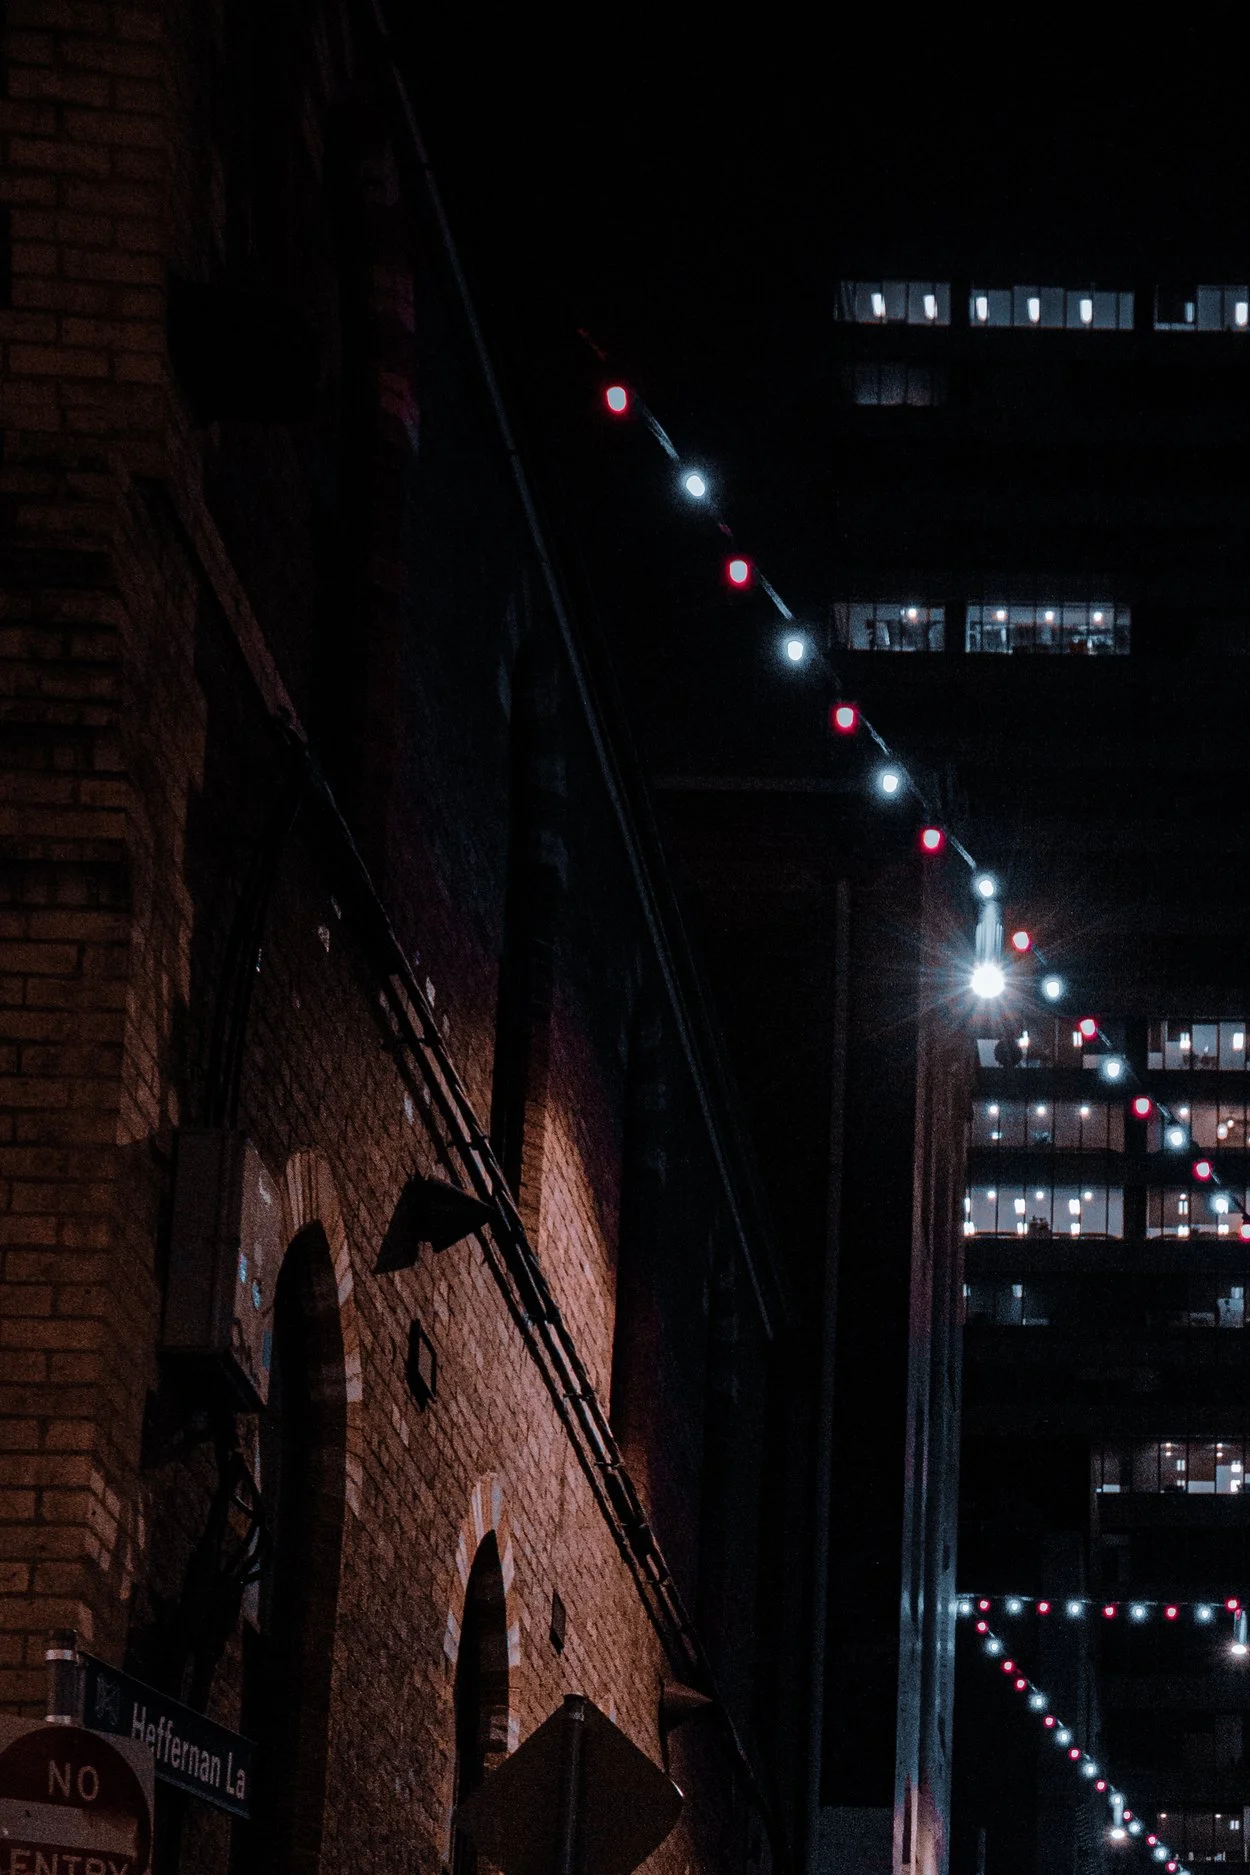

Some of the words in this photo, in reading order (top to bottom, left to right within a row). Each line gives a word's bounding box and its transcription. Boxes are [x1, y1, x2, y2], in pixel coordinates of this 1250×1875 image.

[48, 1759, 100, 1801] NO
[130, 1701, 221, 1789] Heffernan
[226, 1751, 248, 1800] La
